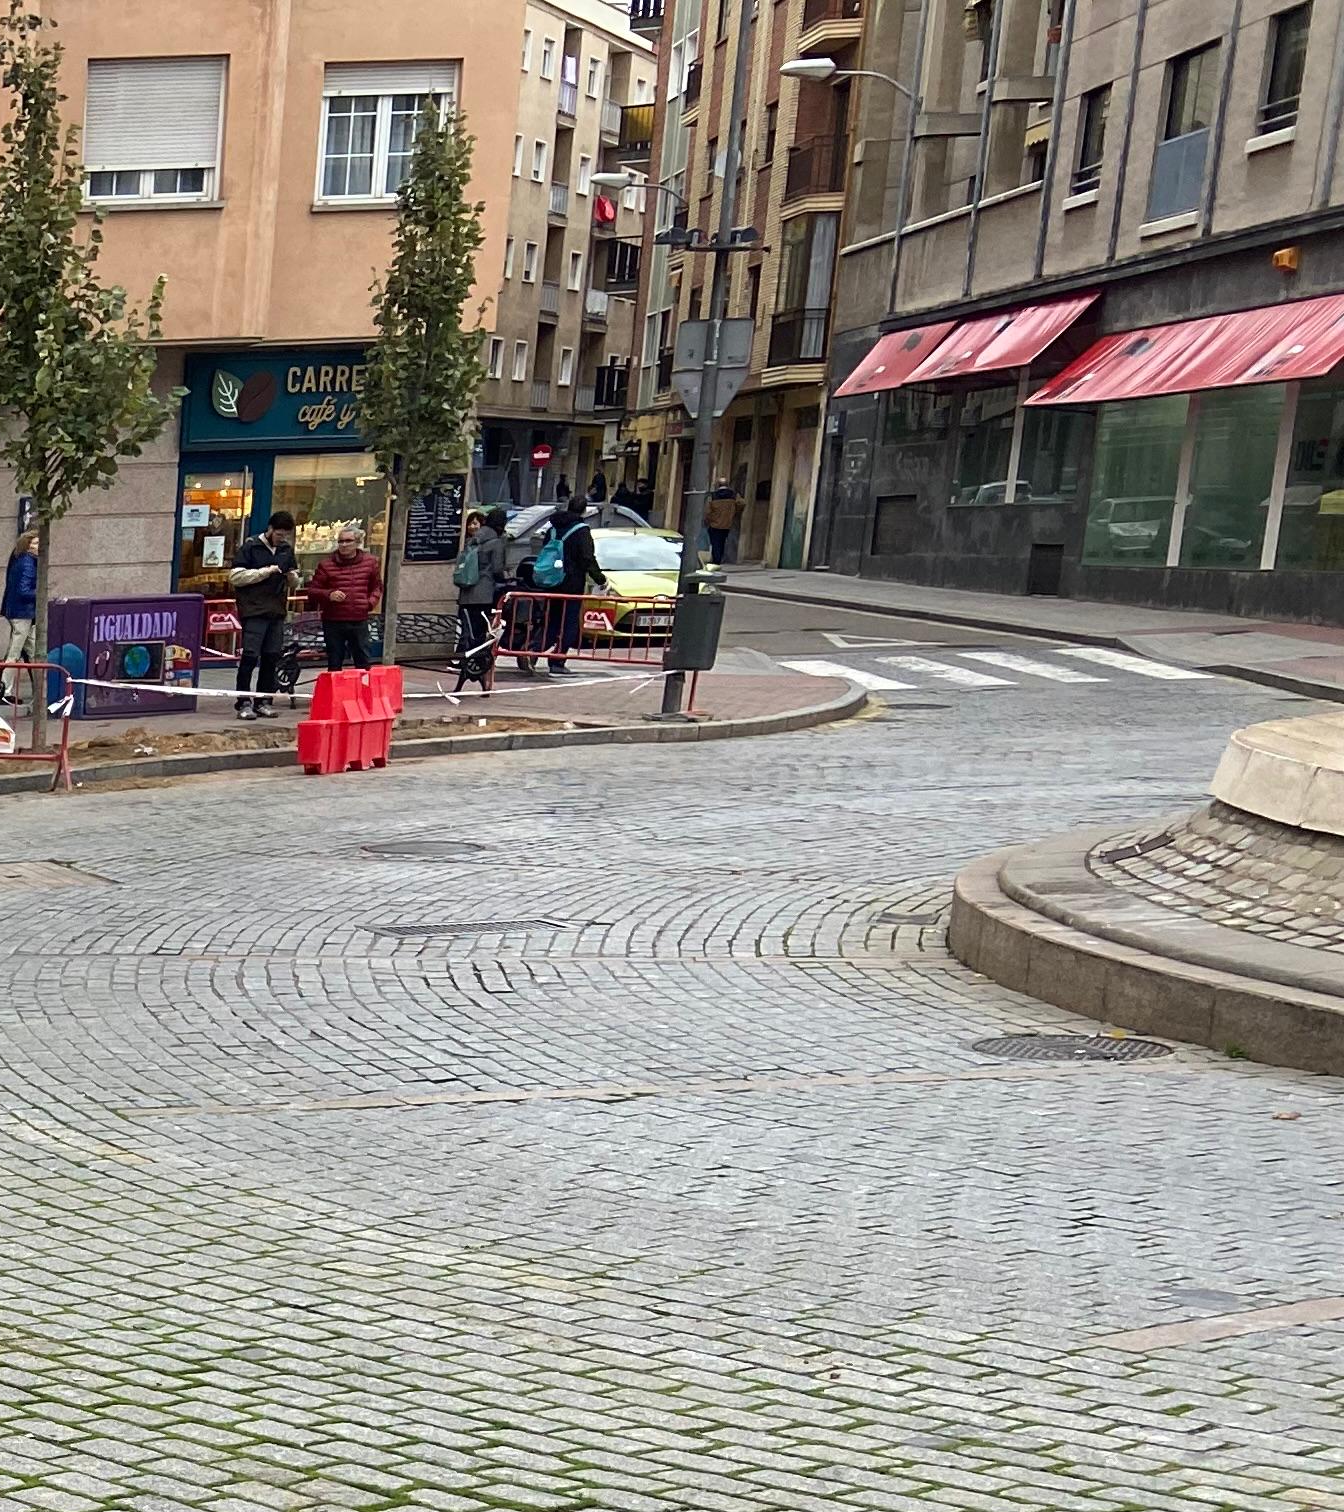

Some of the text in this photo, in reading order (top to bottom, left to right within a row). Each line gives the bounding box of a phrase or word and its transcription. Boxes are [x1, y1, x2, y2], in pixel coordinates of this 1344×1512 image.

[287, 365, 365, 394] CARRE
[298, 396, 357, 430] café y
[93, 611, 177, 642] ¡IGUALDAD!
